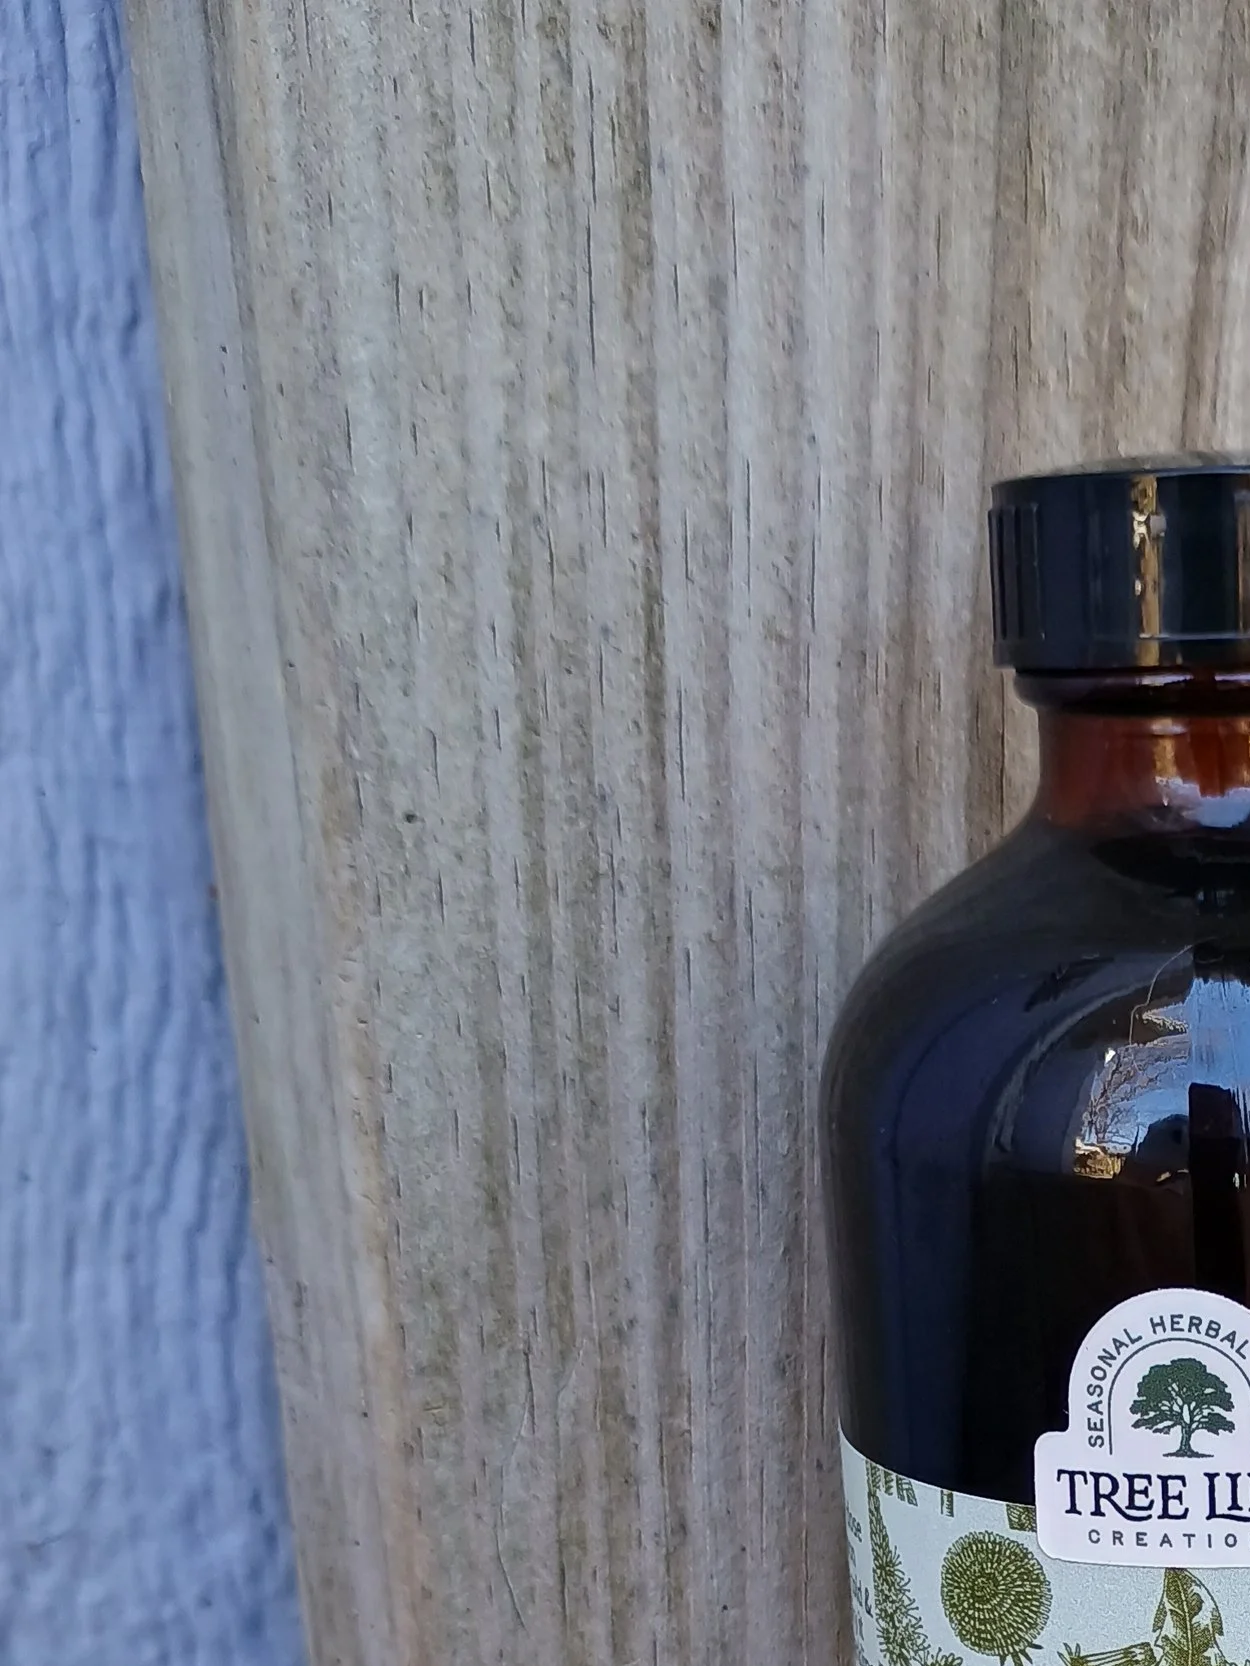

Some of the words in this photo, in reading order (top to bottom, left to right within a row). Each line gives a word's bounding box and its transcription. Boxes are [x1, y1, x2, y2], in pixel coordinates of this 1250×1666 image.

[1087, 1328, 1143, 1448] SEASONAL
[1149, 1314, 1249, 1360] HERBAL
[1056, 1469, 1189, 1522] TREE
